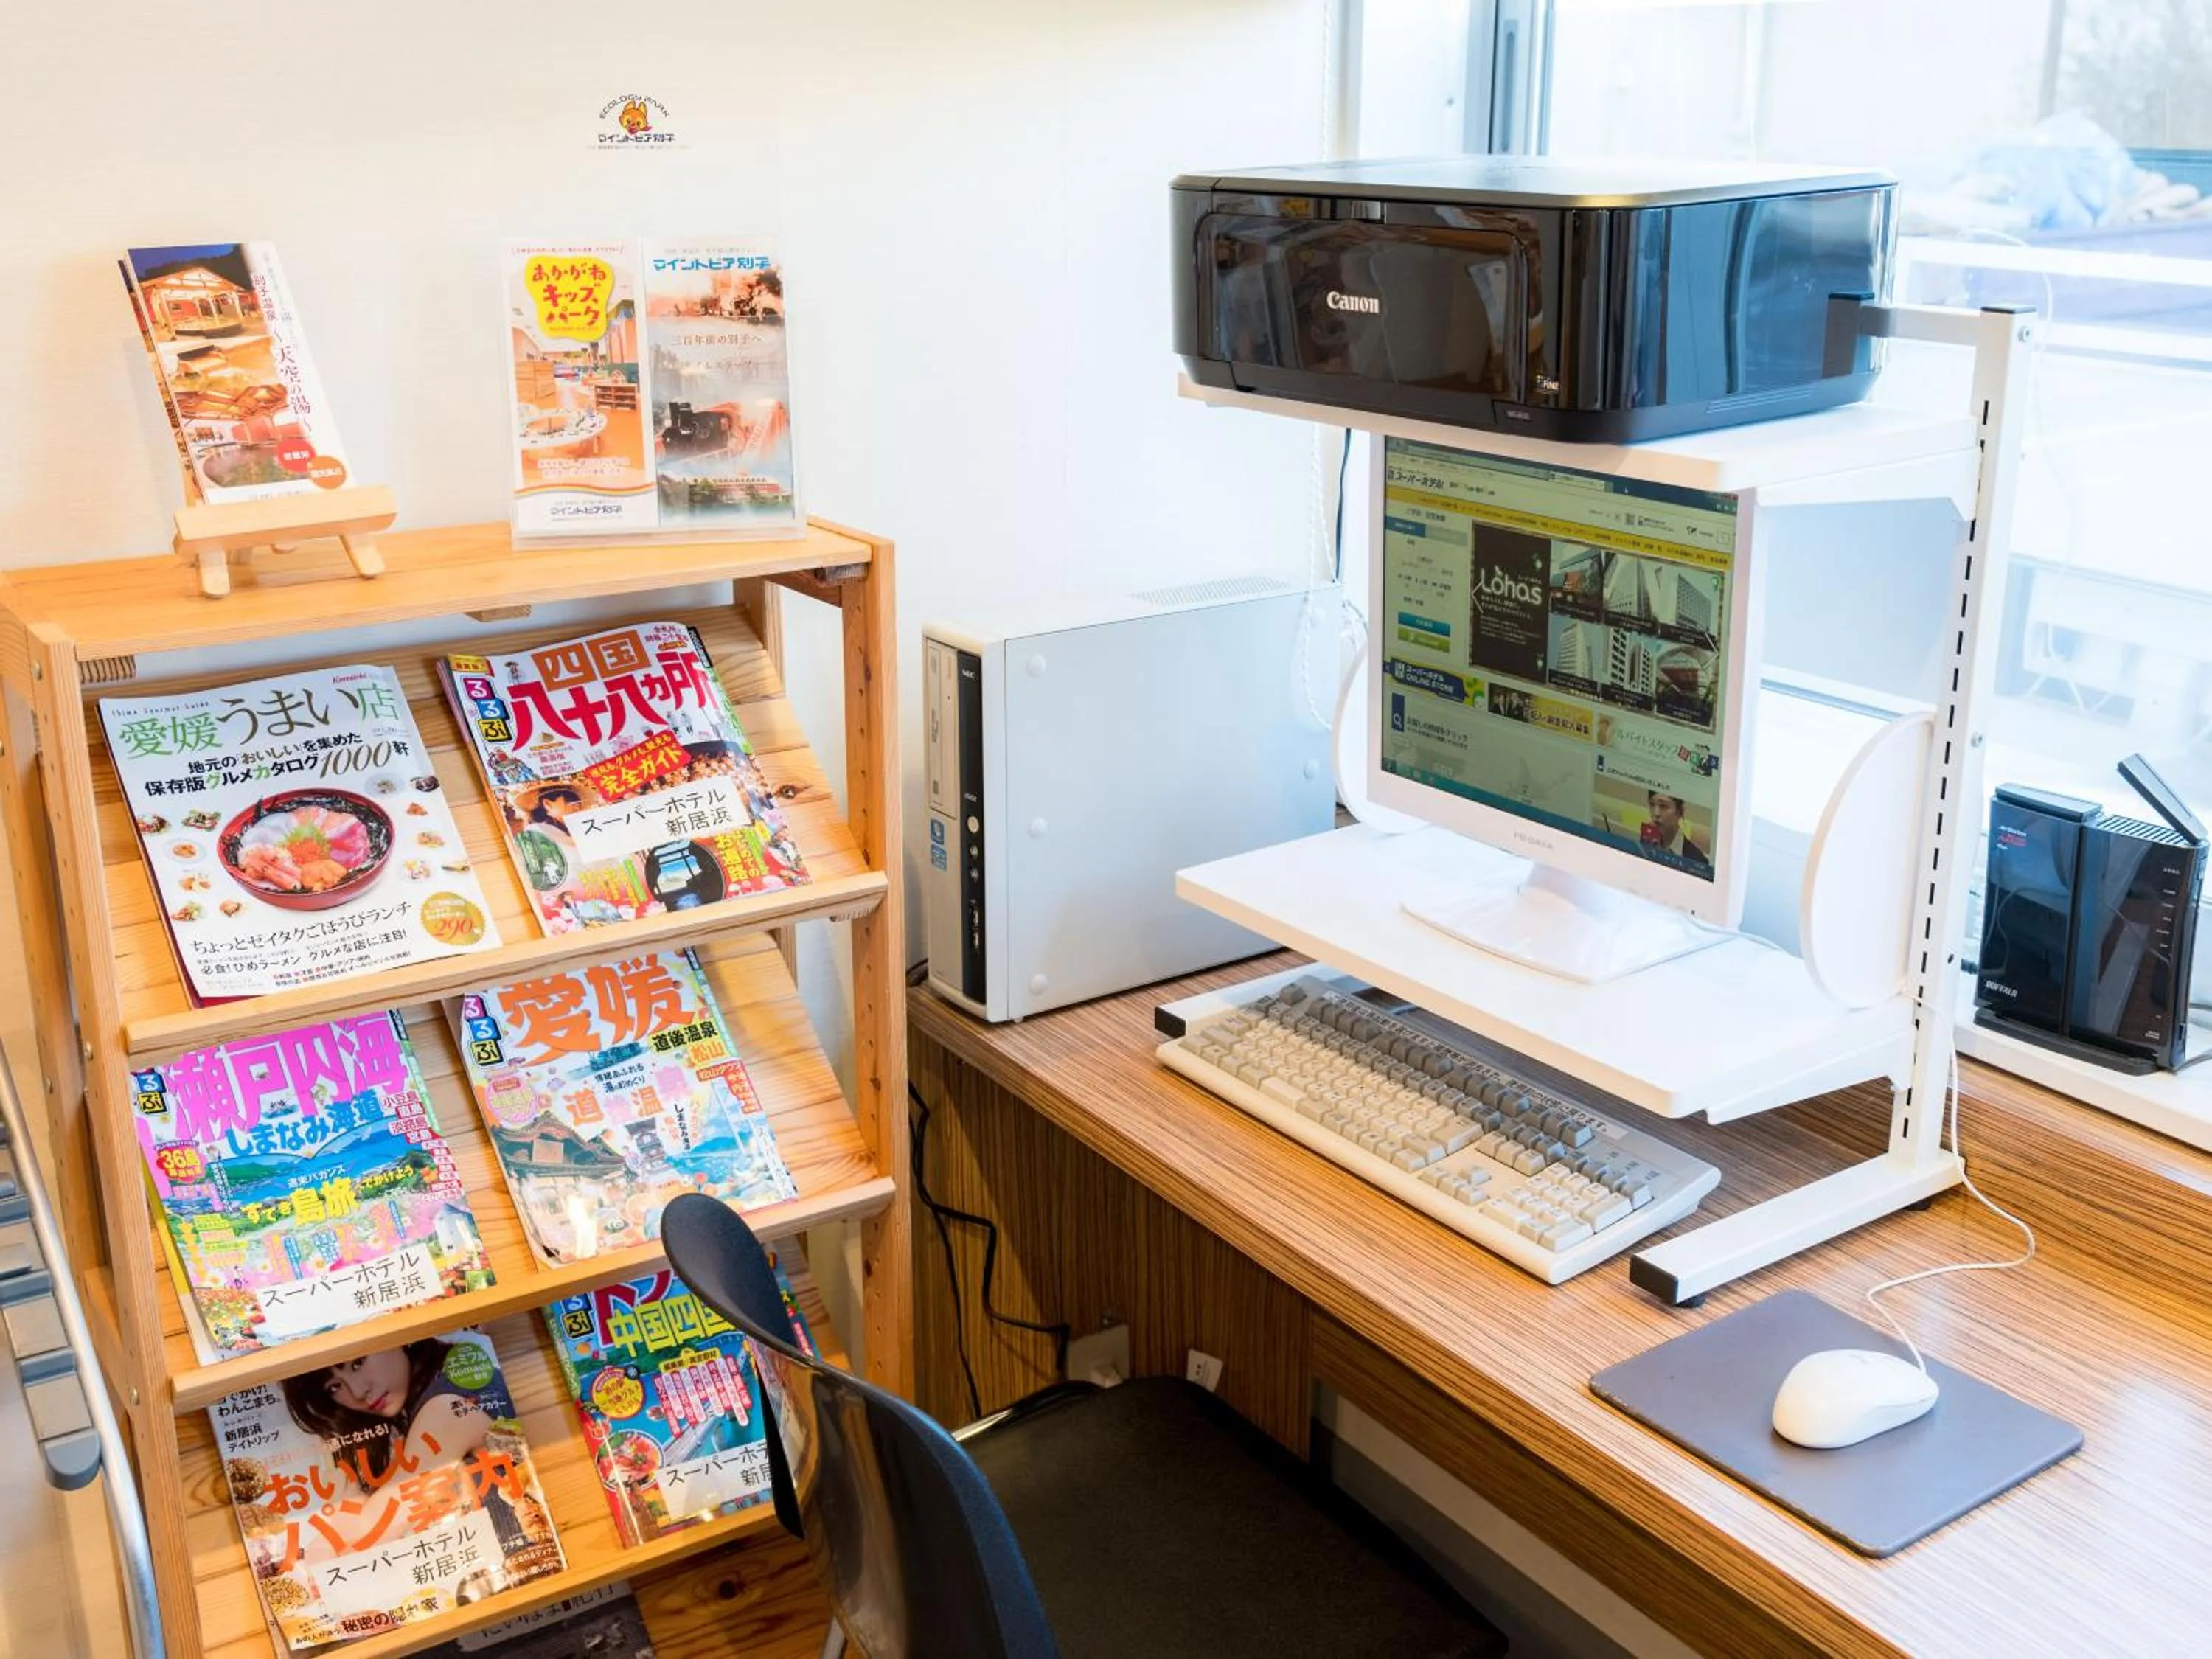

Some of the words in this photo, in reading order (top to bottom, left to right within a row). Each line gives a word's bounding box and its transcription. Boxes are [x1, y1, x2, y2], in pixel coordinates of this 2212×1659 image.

[542, 282, 601, 307] キッズ
[545, 305, 599, 327] パーク
[1326, 291, 1380, 315] Canon
[540, 636, 646, 684] 四国
[119, 682, 400, 759] 愛媛うまい店
[599, 743, 682, 798] 完全ガイド
[581, 787, 727, 836] スーパーホテル
[665, 807, 733, 837] 新居浜
[433, 919, 473, 939] 290
[497, 953, 695, 1068] 愛媛
[651, 1020, 719, 1053] 道後温泉
[688, 1040, 725, 1065] 松山
[164, 1012, 410, 1144] 瀬戸内海
[225, 1090, 386, 1156] しまなみ海道
[262, 1253, 420, 1308] スーパーホテル
[353, 1271, 428, 1310] 新居浜
[224, 1422, 263, 1442] 新居浜
[263, 1430, 443, 1515] おいしい
[666, 1441, 770, 1488] スーパーホテ
[740, 1463, 773, 1488] 新居
[326, 1525, 477, 1587] スーパーホテル
[411, 1546, 481, 1587] 新居浜
